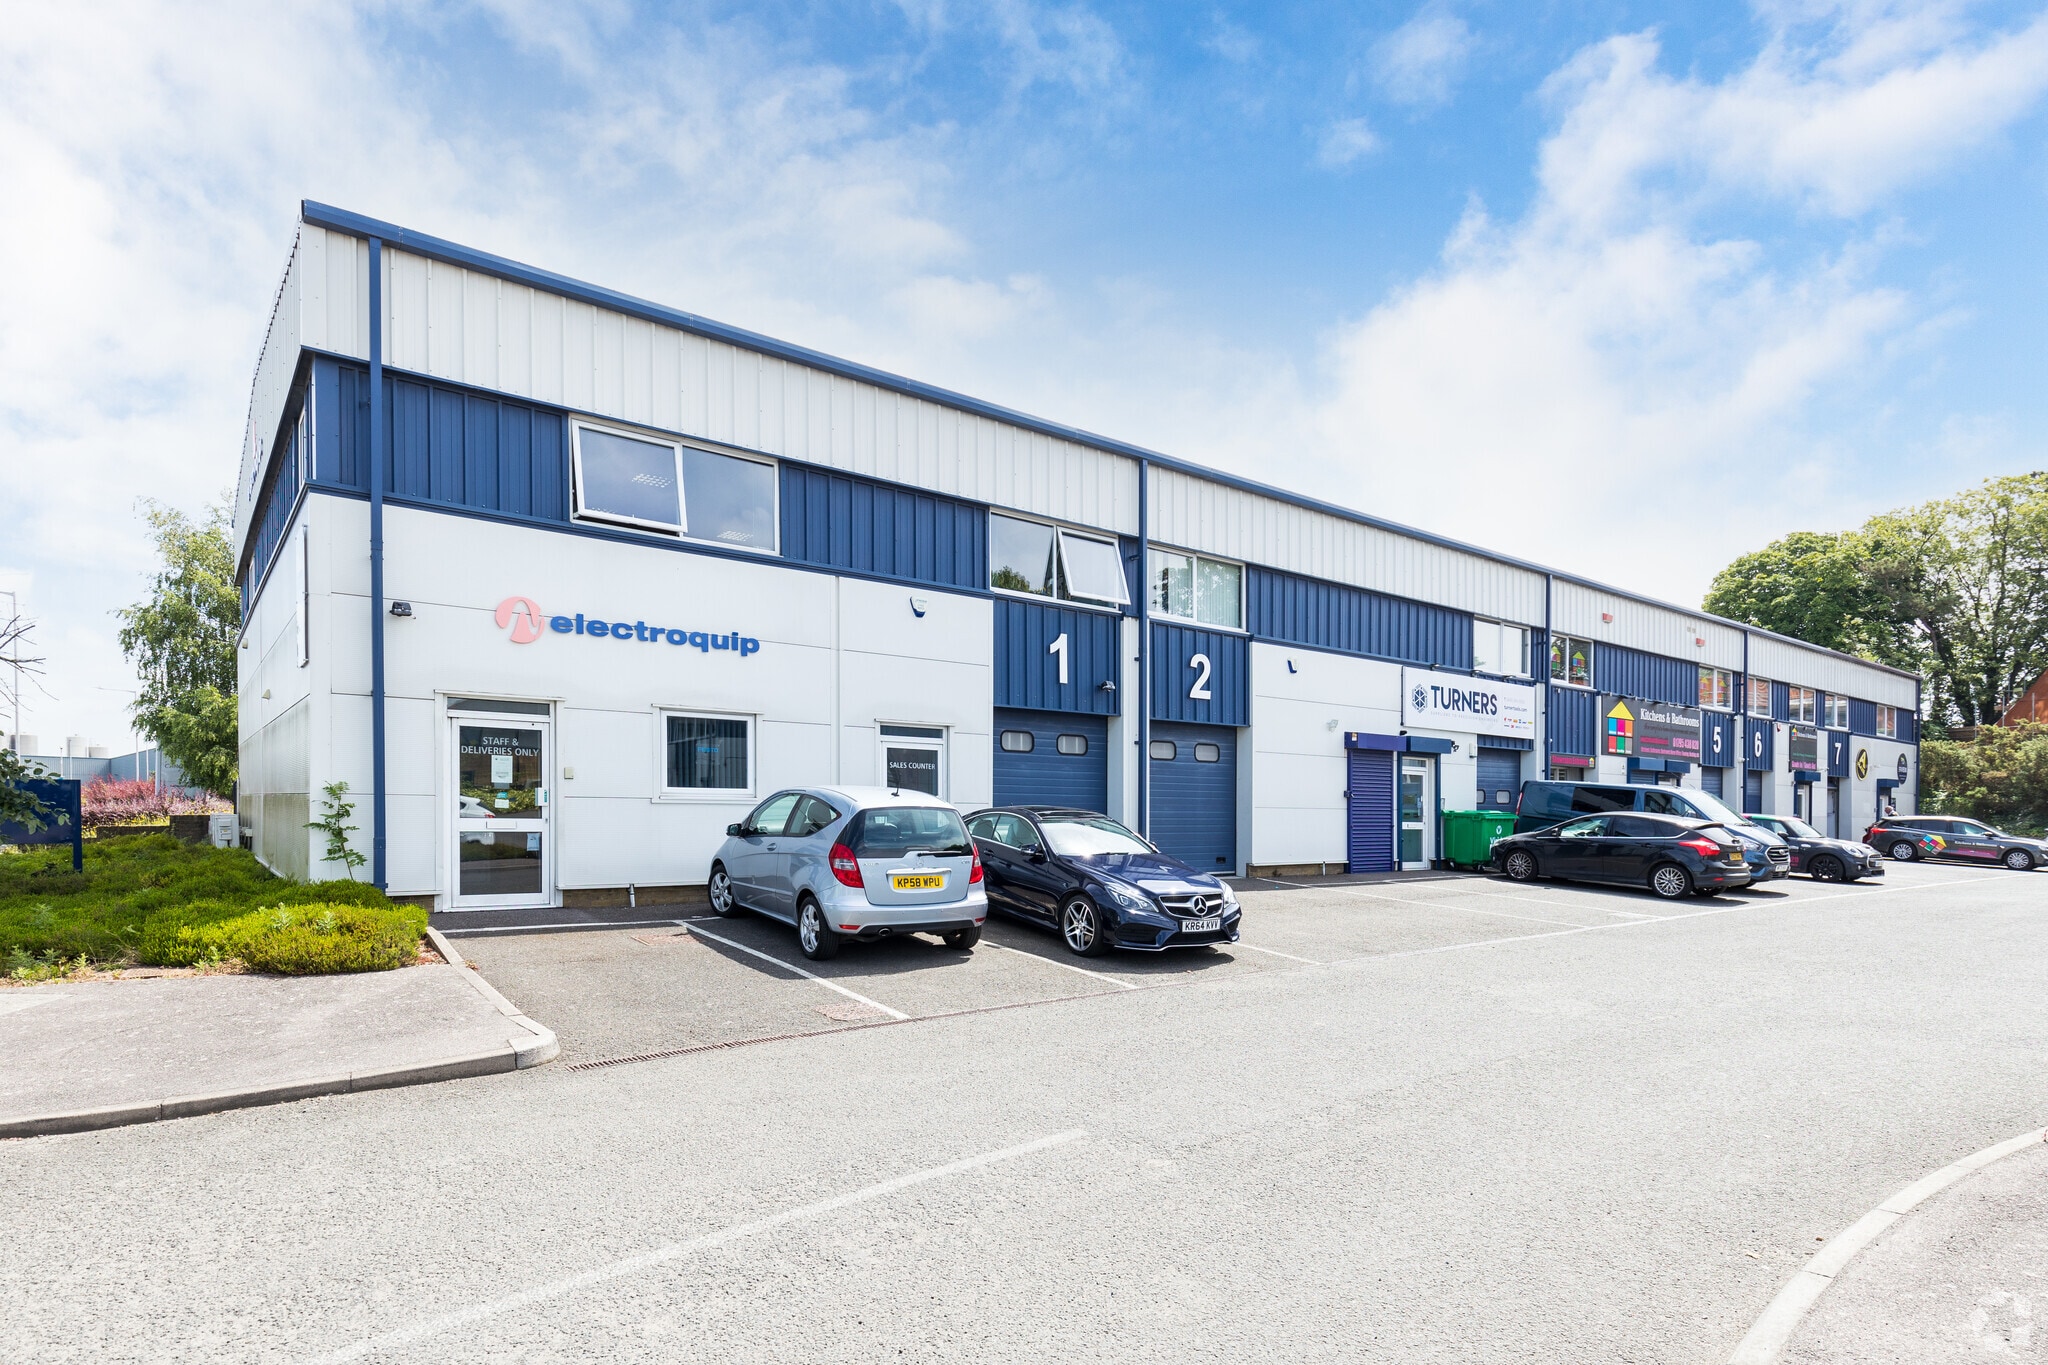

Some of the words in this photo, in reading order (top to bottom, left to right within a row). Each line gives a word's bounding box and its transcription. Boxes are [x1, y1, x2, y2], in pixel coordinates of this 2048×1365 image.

[550, 613, 760, 657] electroquip
[1049, 633, 1068, 684] 1
[1189, 653, 1212, 700] 2
[1430, 685, 1498, 715] TURNERS
[1640, 708, 1666, 723] Kitchens
[1666, 712, 1671, 723] &
[1672, 713, 1700, 727] Bathrooms
[461, 746, 513, 756] DELIVERIES
[515, 748, 540, 757] ONLY
[482, 736, 510, 746] STAFF
[512, 738, 519, 746] &
[1713, 726, 1722, 754] 5
[1754, 731, 1762, 758] 6
[1834, 742, 1842, 765] 7
[889, 761, 908, 769] SALES
[908, 762, 936, 770] COUNTER
[897, 878, 921, 888] KP58
[924, 877, 940, 887] WPU
[1185, 921, 1205, 930] KR64
[1205, 920, 1219, 930] KVV
